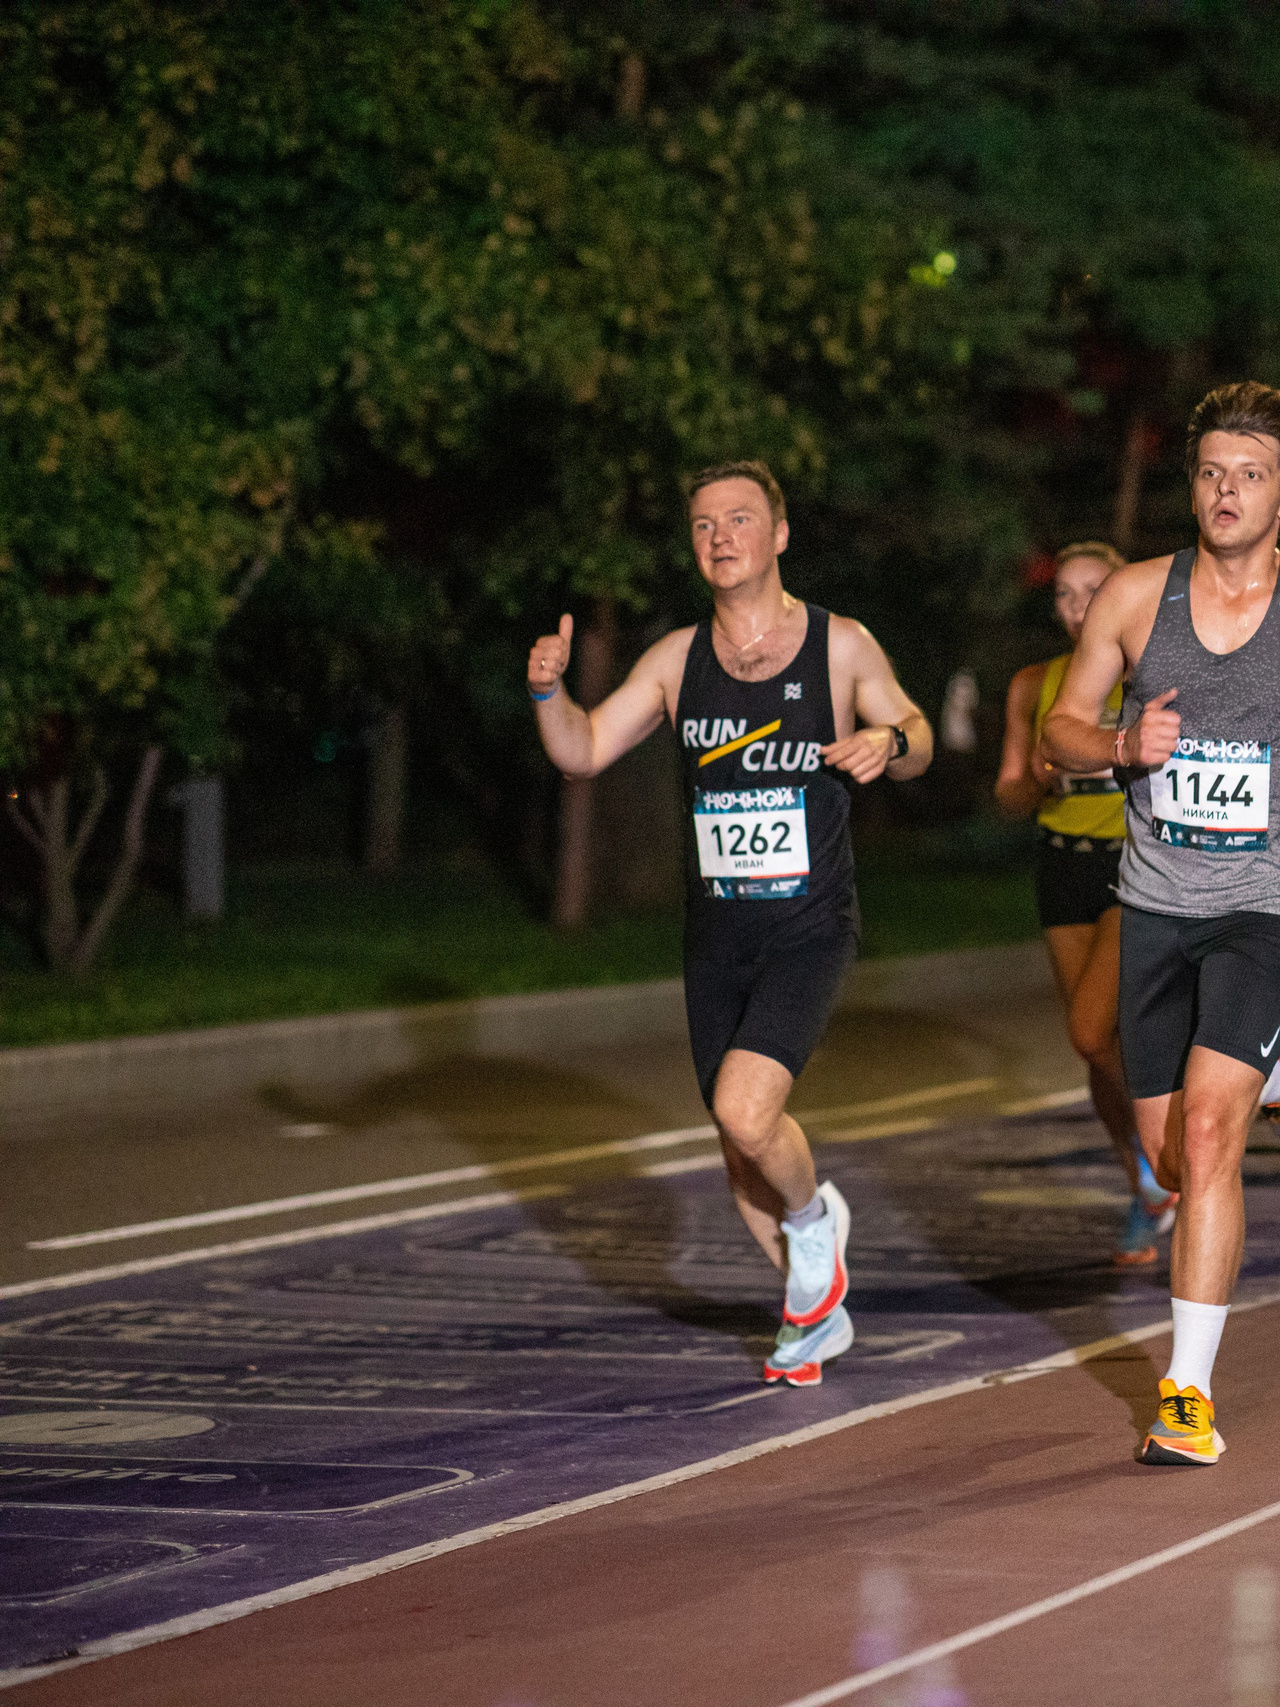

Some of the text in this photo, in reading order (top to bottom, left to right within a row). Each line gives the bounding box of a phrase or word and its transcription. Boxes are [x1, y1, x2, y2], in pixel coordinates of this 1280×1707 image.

[683, 718, 747, 748] RUN
[1176, 737, 1261, 759] ОЧНОЙ
[741, 741, 822, 772] CLUB
[1166, 768, 1254, 807] 1144
[1182, 808, 1229, 820] НИКИТА
[711, 821, 792, 857] 1262
[734, 859, 764, 869] ИВАН
